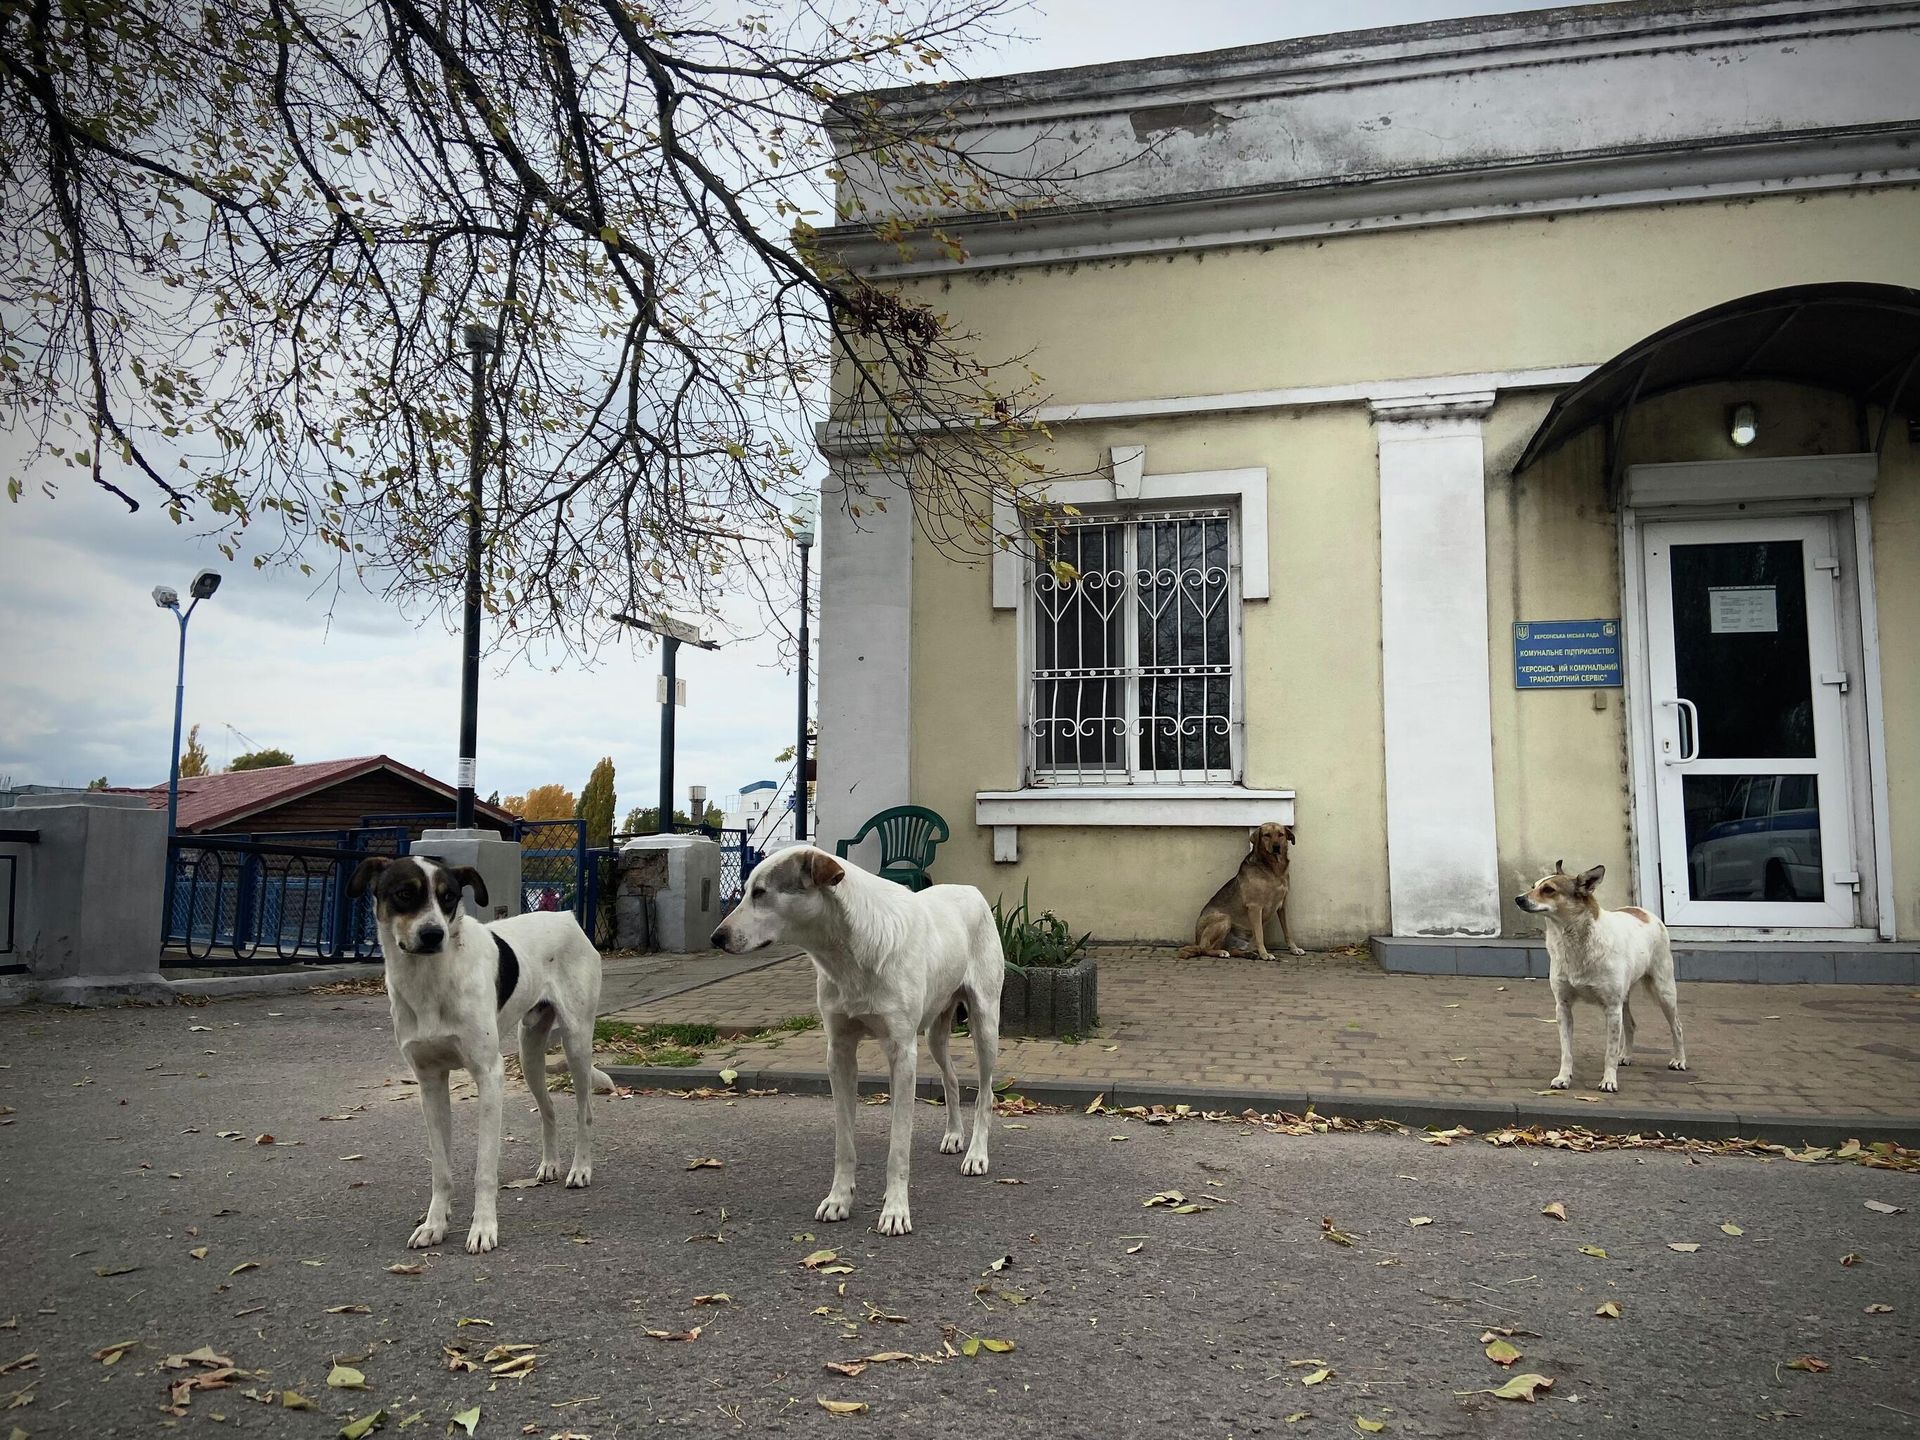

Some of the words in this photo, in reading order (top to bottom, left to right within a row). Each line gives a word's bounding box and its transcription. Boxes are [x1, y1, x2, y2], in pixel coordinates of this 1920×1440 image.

[1519, 649, 1563, 657] КОМУНАЛЬНЕ
[1564, 647, 1615, 656] ПІДПРИЄМСТВО
[1518, 664, 1568, 673] "ХЕРСОНСЬИЙ
[1569, 662, 1618, 671] КОМУНАЛЬНИЙ
[1529, 674, 1580, 683] ТРАНСПОРТНИЙ
